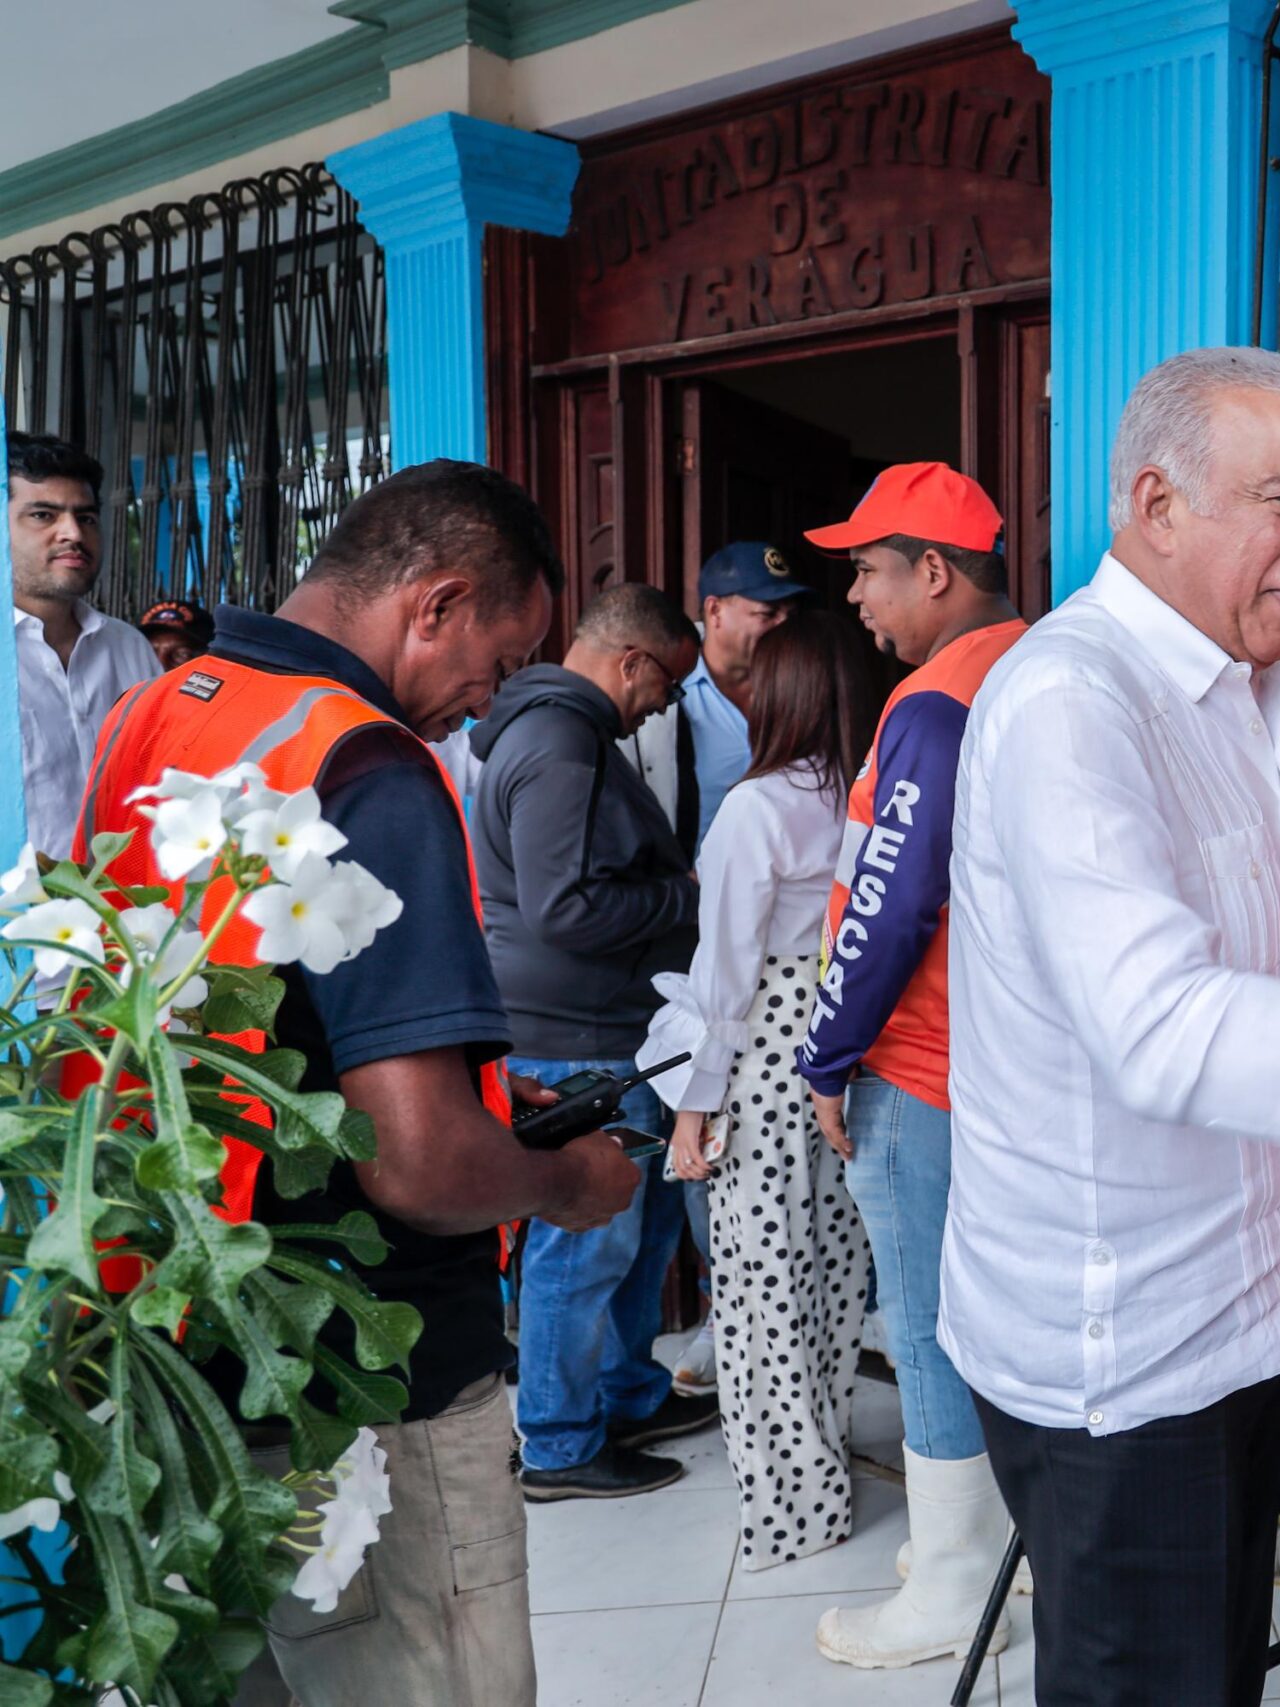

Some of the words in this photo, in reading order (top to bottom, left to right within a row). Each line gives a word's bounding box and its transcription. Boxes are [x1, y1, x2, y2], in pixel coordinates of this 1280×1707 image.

[661, 212, 1000, 343] VERAGUA
[769, 168, 849, 256] DE
[802, 779, 921, 1066] RESCATE
